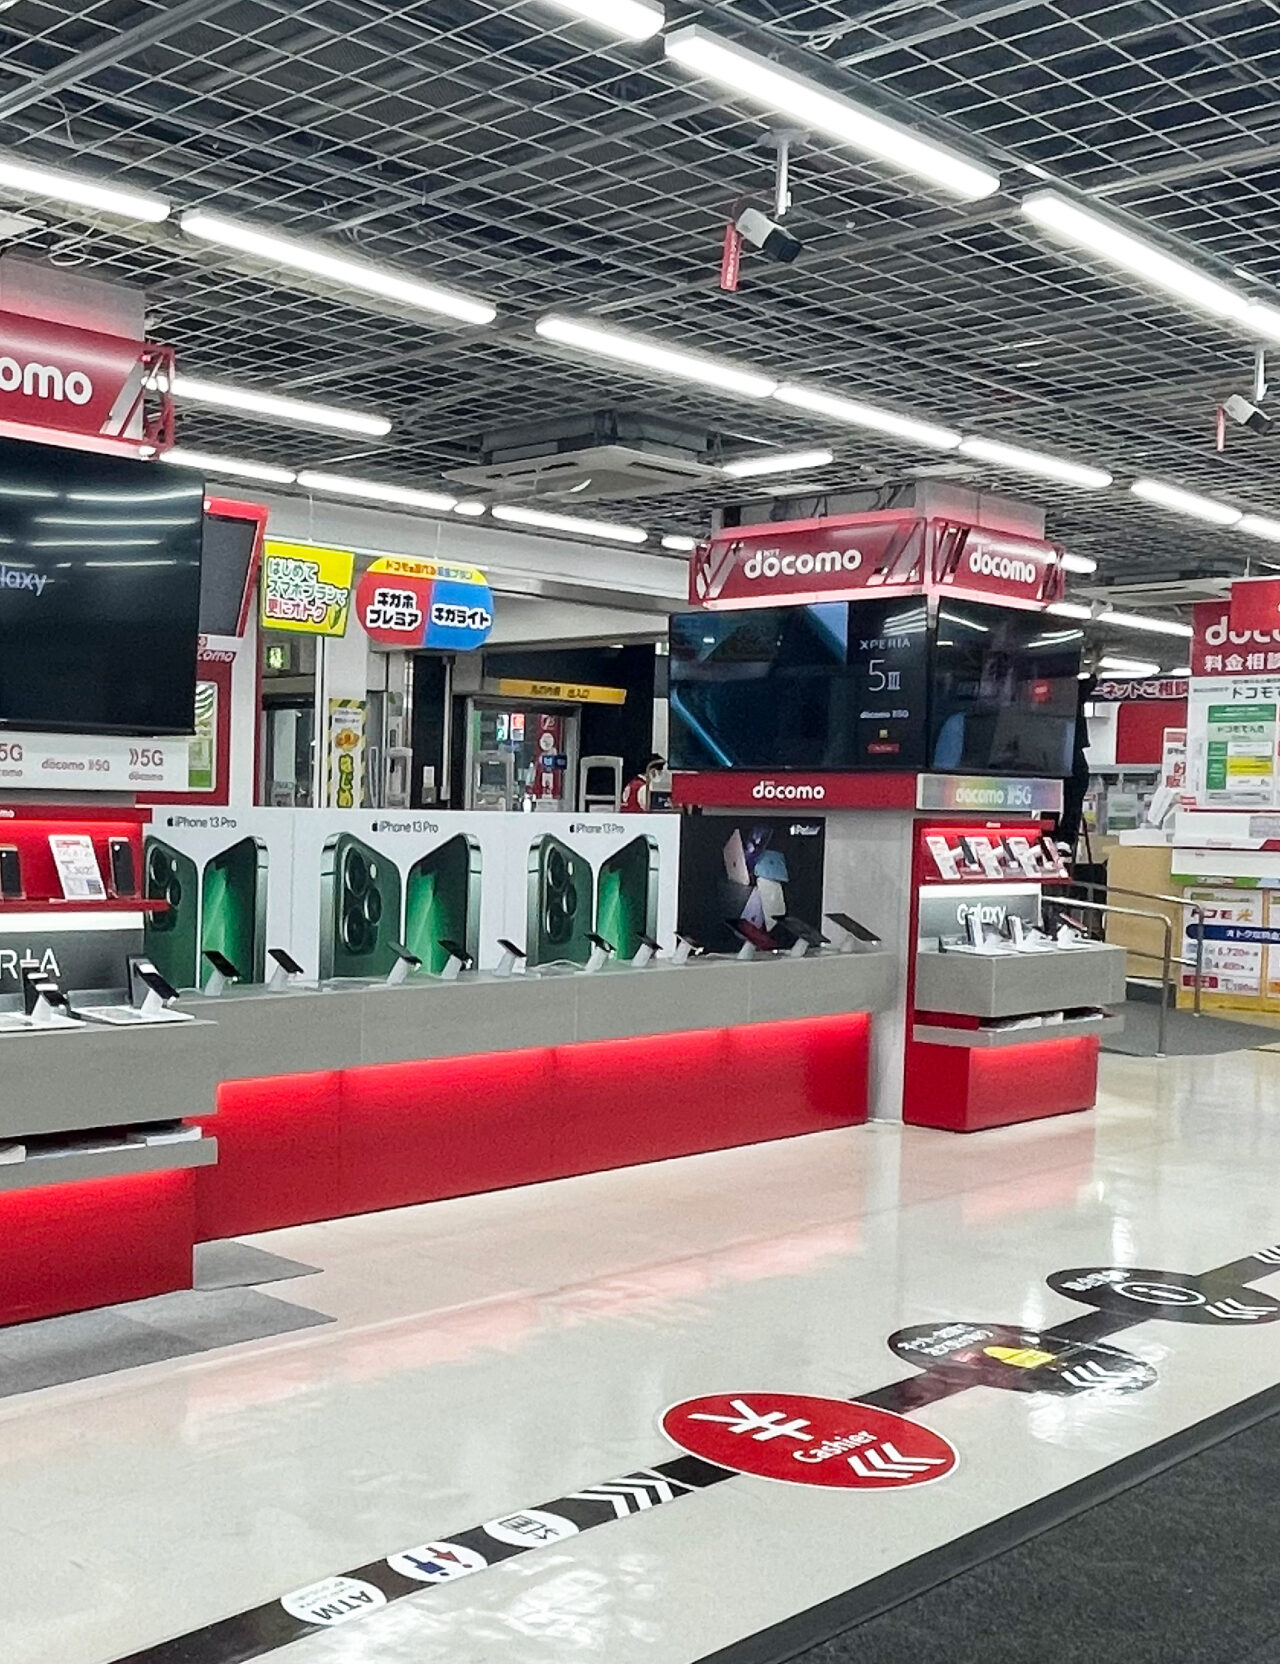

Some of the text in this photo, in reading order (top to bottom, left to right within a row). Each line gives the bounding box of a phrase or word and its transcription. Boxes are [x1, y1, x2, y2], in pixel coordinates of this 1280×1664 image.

[269, 558, 318, 582] はじめて
[744, 549, 862, 579] docomo
[969, 545, 1036, 584] docomo
[377, 592, 414, 608] ギガホ
[369, 607, 419, 627] プレミア
[434, 606, 490, 627] ギガライト
[860, 637, 911, 650] XPERIA
[42, 758, 85, 770] docomo
[140, 748, 164, 766] 5G
[753, 780, 825, 800] docomo
[956, 786, 1003, 804] docomo
[175, 816, 237, 829] iPhone 13 Pro
[379, 821, 439, 834] iPhone 13 Pro
[575, 823, 600, 835] iPhone
[611, 824, 625, 835] Pro
[956, 902, 1008, 927] Galaxy
[792, 1430, 878, 1464] Cashier
[311, 1590, 374, 1621] ATM
